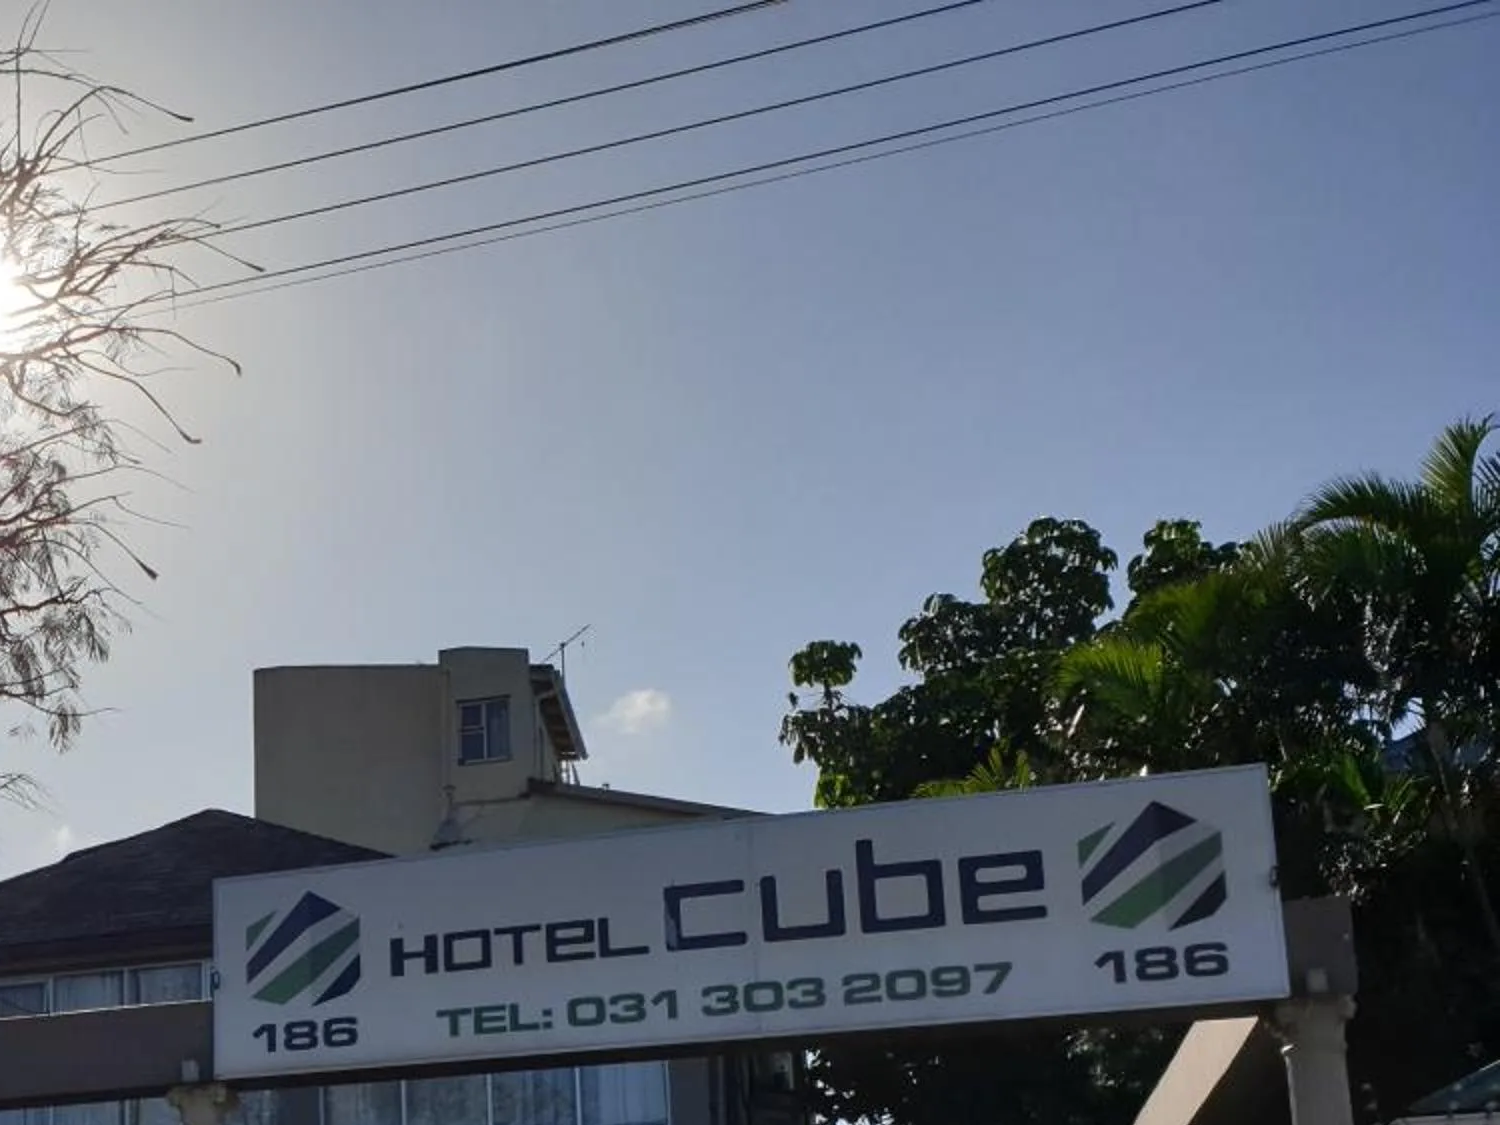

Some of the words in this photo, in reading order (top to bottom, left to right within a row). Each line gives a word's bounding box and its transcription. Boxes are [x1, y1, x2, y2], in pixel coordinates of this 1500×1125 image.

[389, 917, 650, 978] HOTEL
[1094, 942, 1230, 984] 186
[436, 1002, 554, 1038] TEL:
[566, 989, 679, 1028] 031
[702, 976, 827, 1017] 303
[842, 961, 1013, 1006] 2097
[252, 1016, 359, 1053] 186
